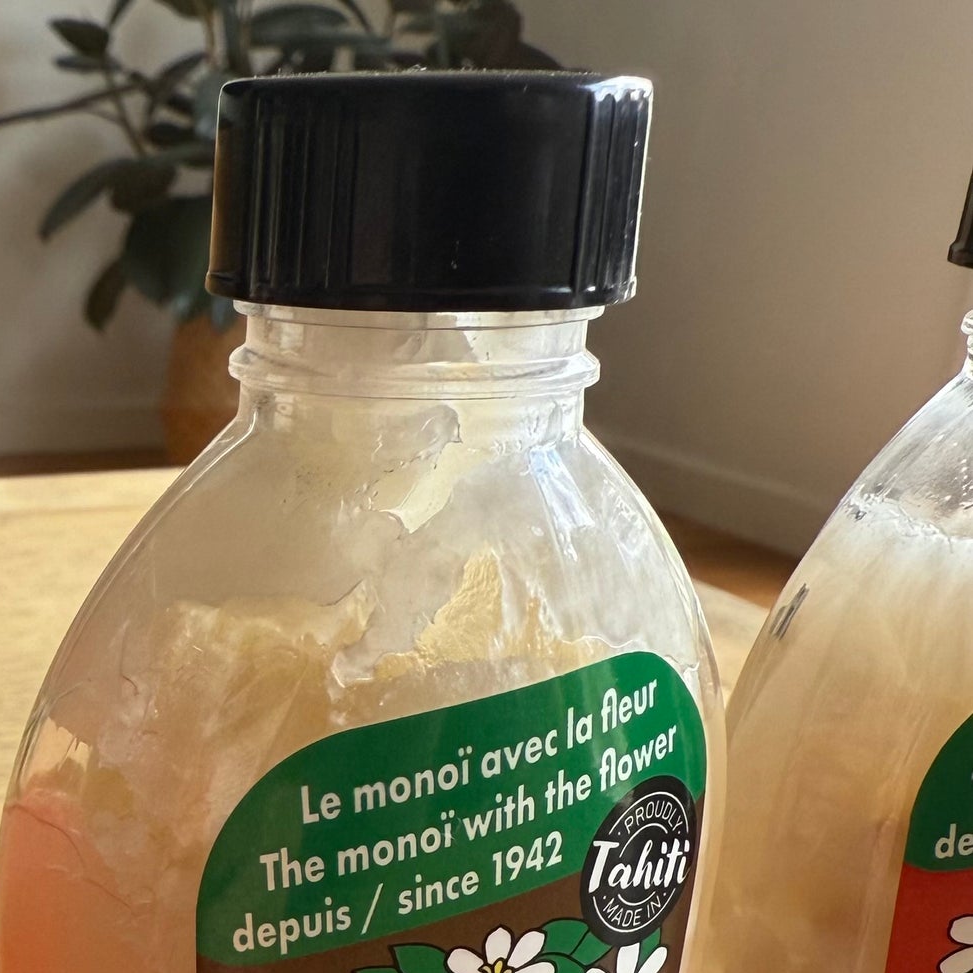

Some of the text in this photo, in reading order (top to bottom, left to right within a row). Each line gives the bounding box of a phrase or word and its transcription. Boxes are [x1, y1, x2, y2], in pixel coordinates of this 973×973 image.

[301, 679, 658, 825] Le monoï avec la fleur
[259, 724, 678, 892] The monoï with the flower
[624, 800, 683, 834] PROUDLY
[232, 831, 564, 956] depuis / since 1942
[588, 838, 691, 893] Tahiti
[603, 895, 661, 927] MADE IN
